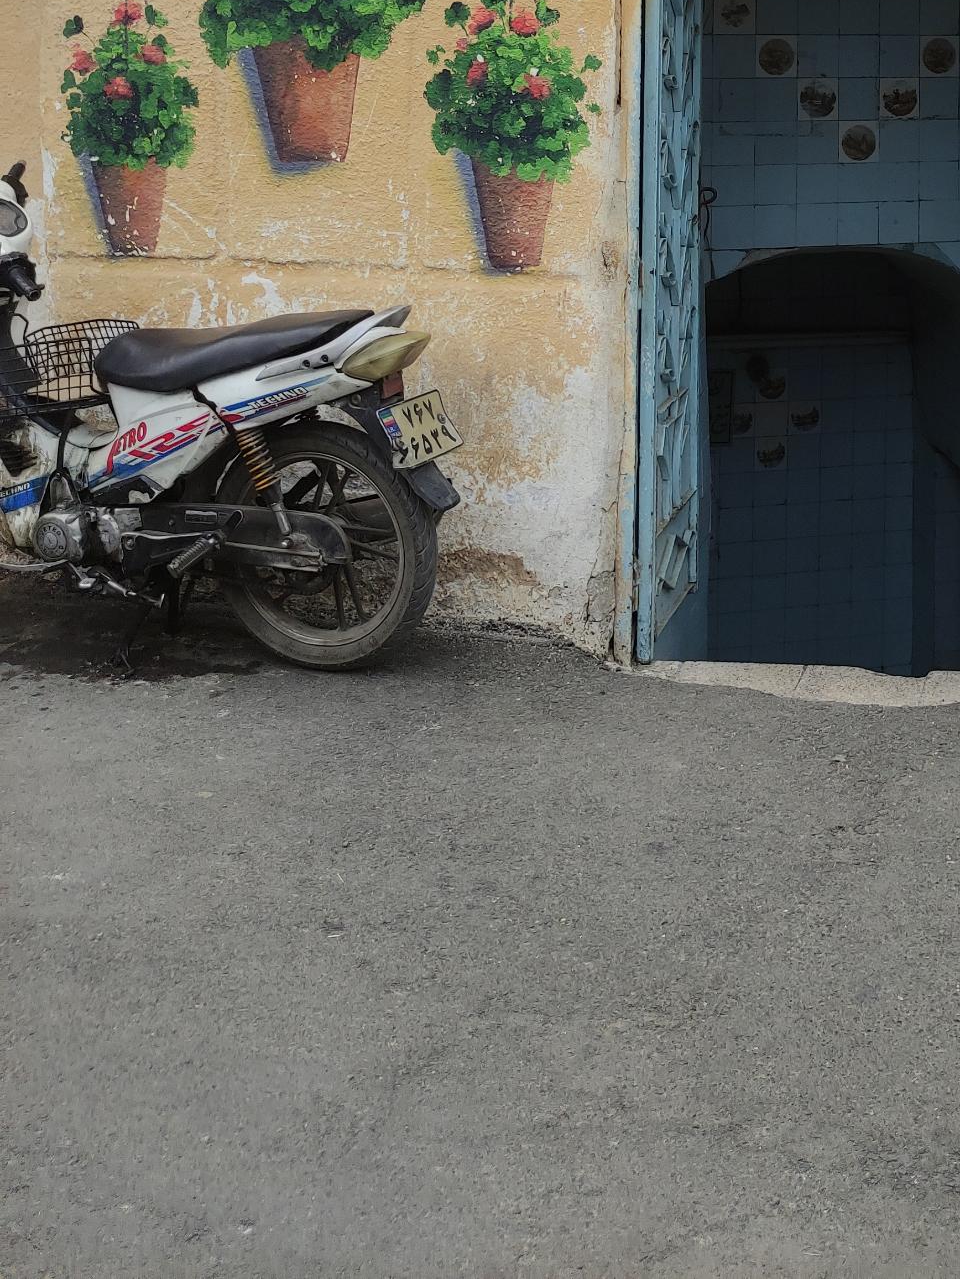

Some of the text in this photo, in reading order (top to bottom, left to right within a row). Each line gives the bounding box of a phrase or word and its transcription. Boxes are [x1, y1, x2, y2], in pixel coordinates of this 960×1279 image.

[247, 385, 309, 410] TECHNO
[401, 398, 436, 428] ۷۶۷
[0, 482, 31, 498] ECHNO
